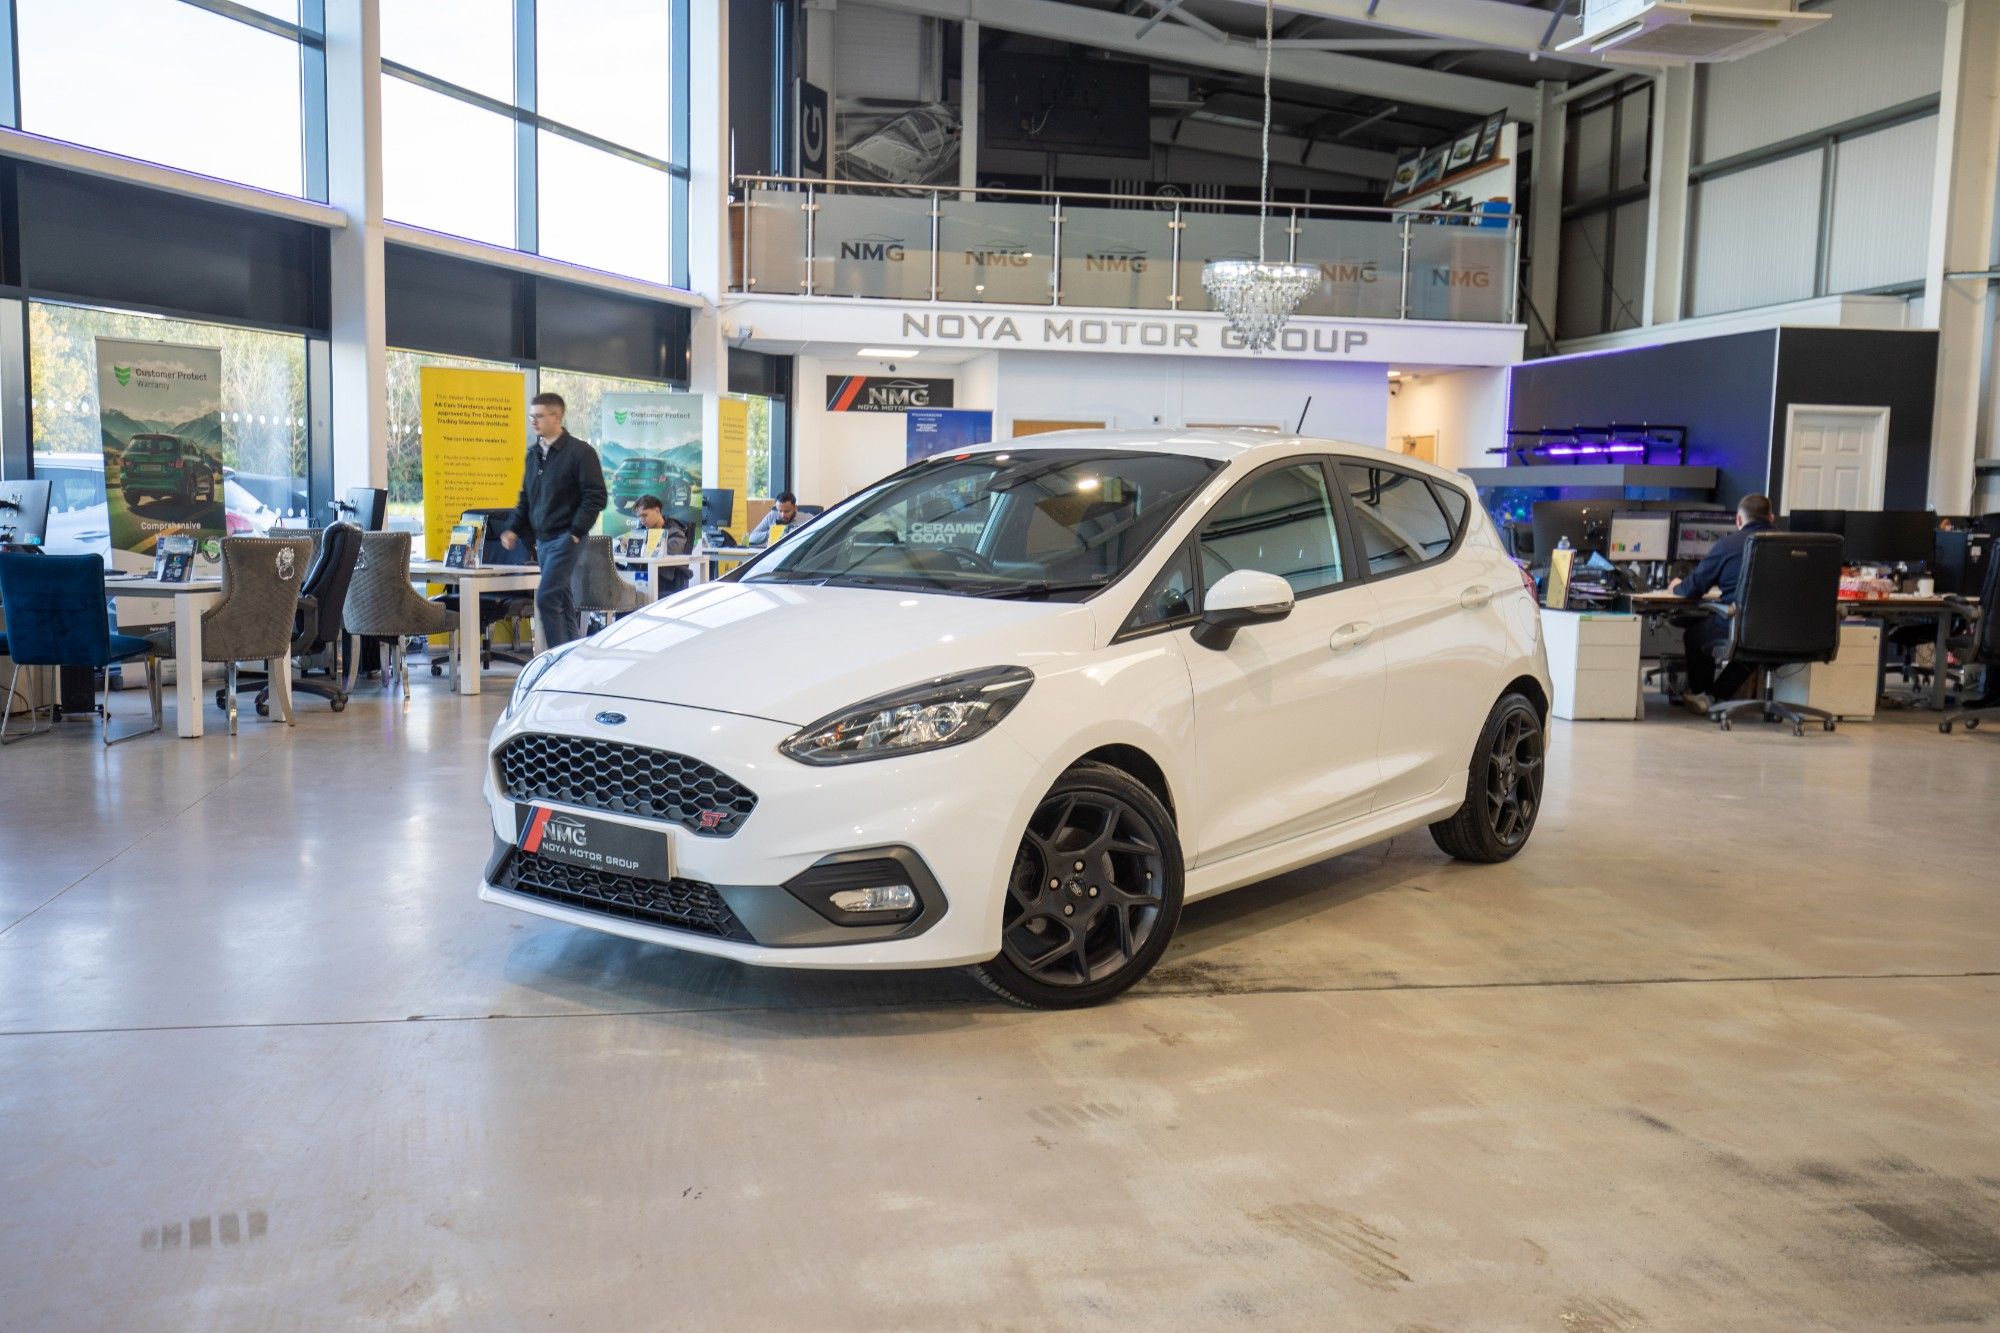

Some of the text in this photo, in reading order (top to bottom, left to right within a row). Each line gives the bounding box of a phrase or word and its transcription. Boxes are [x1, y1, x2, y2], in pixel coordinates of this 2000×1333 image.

[841, 241, 905, 262] NMG
[965, 250, 1029, 267] NMG
[1086, 252, 1147, 274] NMG
[1320, 263, 1378, 284] NMG
[1432, 267, 1490, 288] NMG
[902, 313, 1021, 342] NOYA
[1043, 318, 1198, 348] MOTOR
[135, 368, 207, 381] Customer Protect
[136, 380, 170, 391] Warranty
[868, 387, 930, 406] NMG
[141, 521, 202, 531] Comprehensive
[911, 522, 985, 534] CERAMIC
[911, 533, 957, 544] COAT
[700, 810, 728, 828] ST
[542, 821, 587, 846] NMG
[542, 842, 567, 854] NOYA
[569, 848, 603, 862] MOTOR
[605, 855, 640, 870] GROUP
